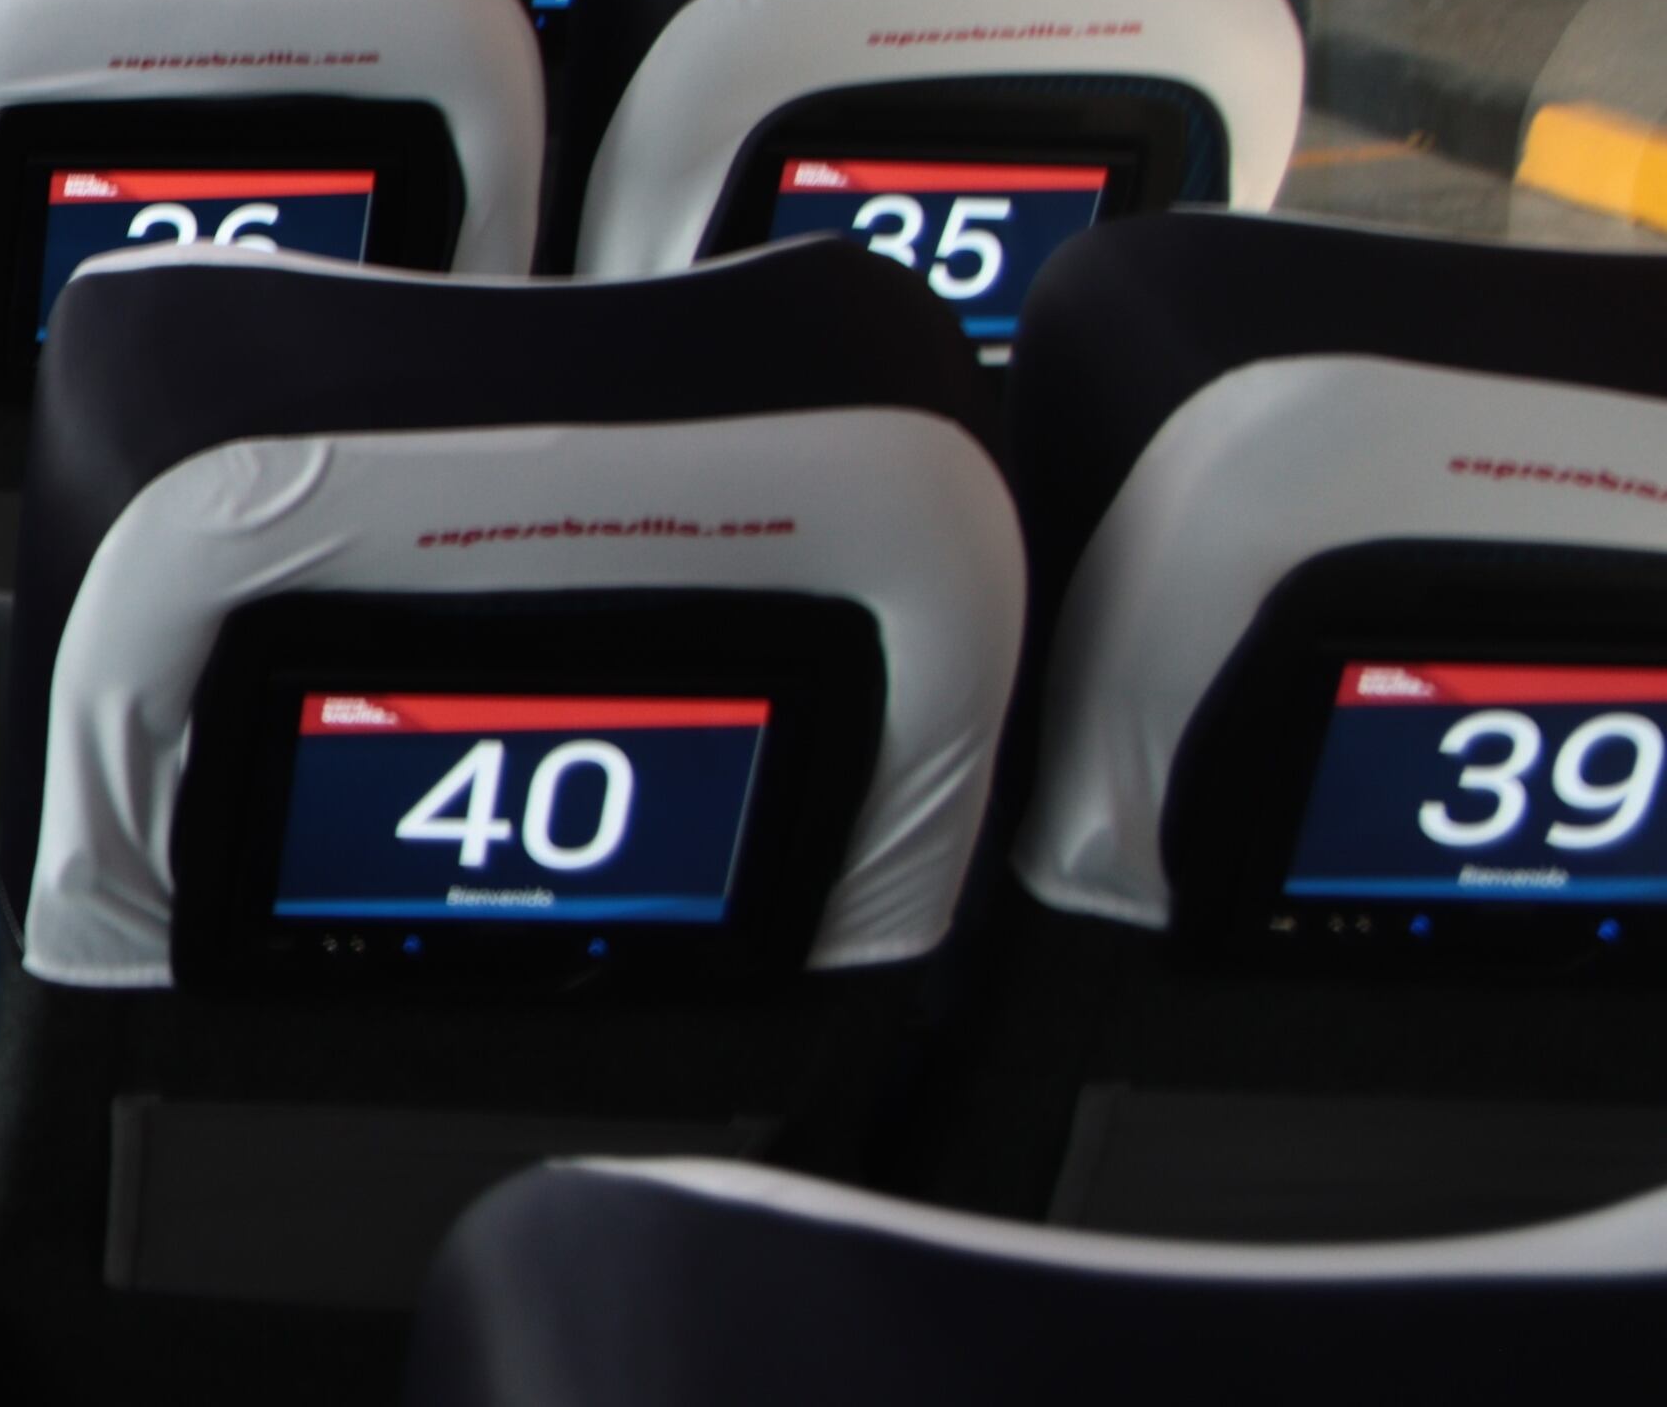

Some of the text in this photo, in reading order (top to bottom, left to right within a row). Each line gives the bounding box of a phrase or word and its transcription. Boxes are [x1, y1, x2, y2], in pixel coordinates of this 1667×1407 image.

[851, 194, 1011, 300] 35
[418, 516, 797, 550] expresobrasilia.com
[395, 740, 634, 871] 40
[1419, 709, 1666, 849] 39
